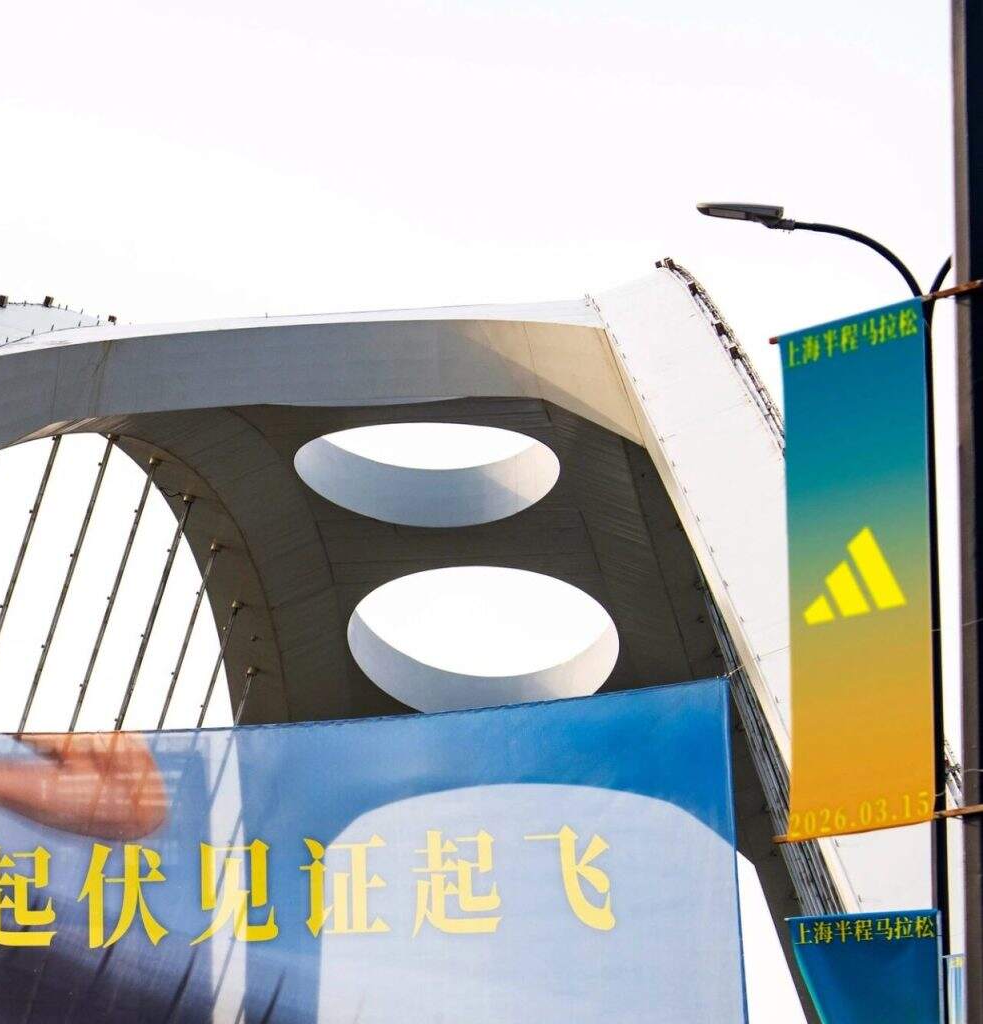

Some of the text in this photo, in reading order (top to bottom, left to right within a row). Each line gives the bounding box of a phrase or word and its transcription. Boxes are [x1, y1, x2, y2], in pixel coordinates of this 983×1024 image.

[790, 792, 930, 838] 2026.03.15
[796, 915, 935, 945] 上海半程马拉松
